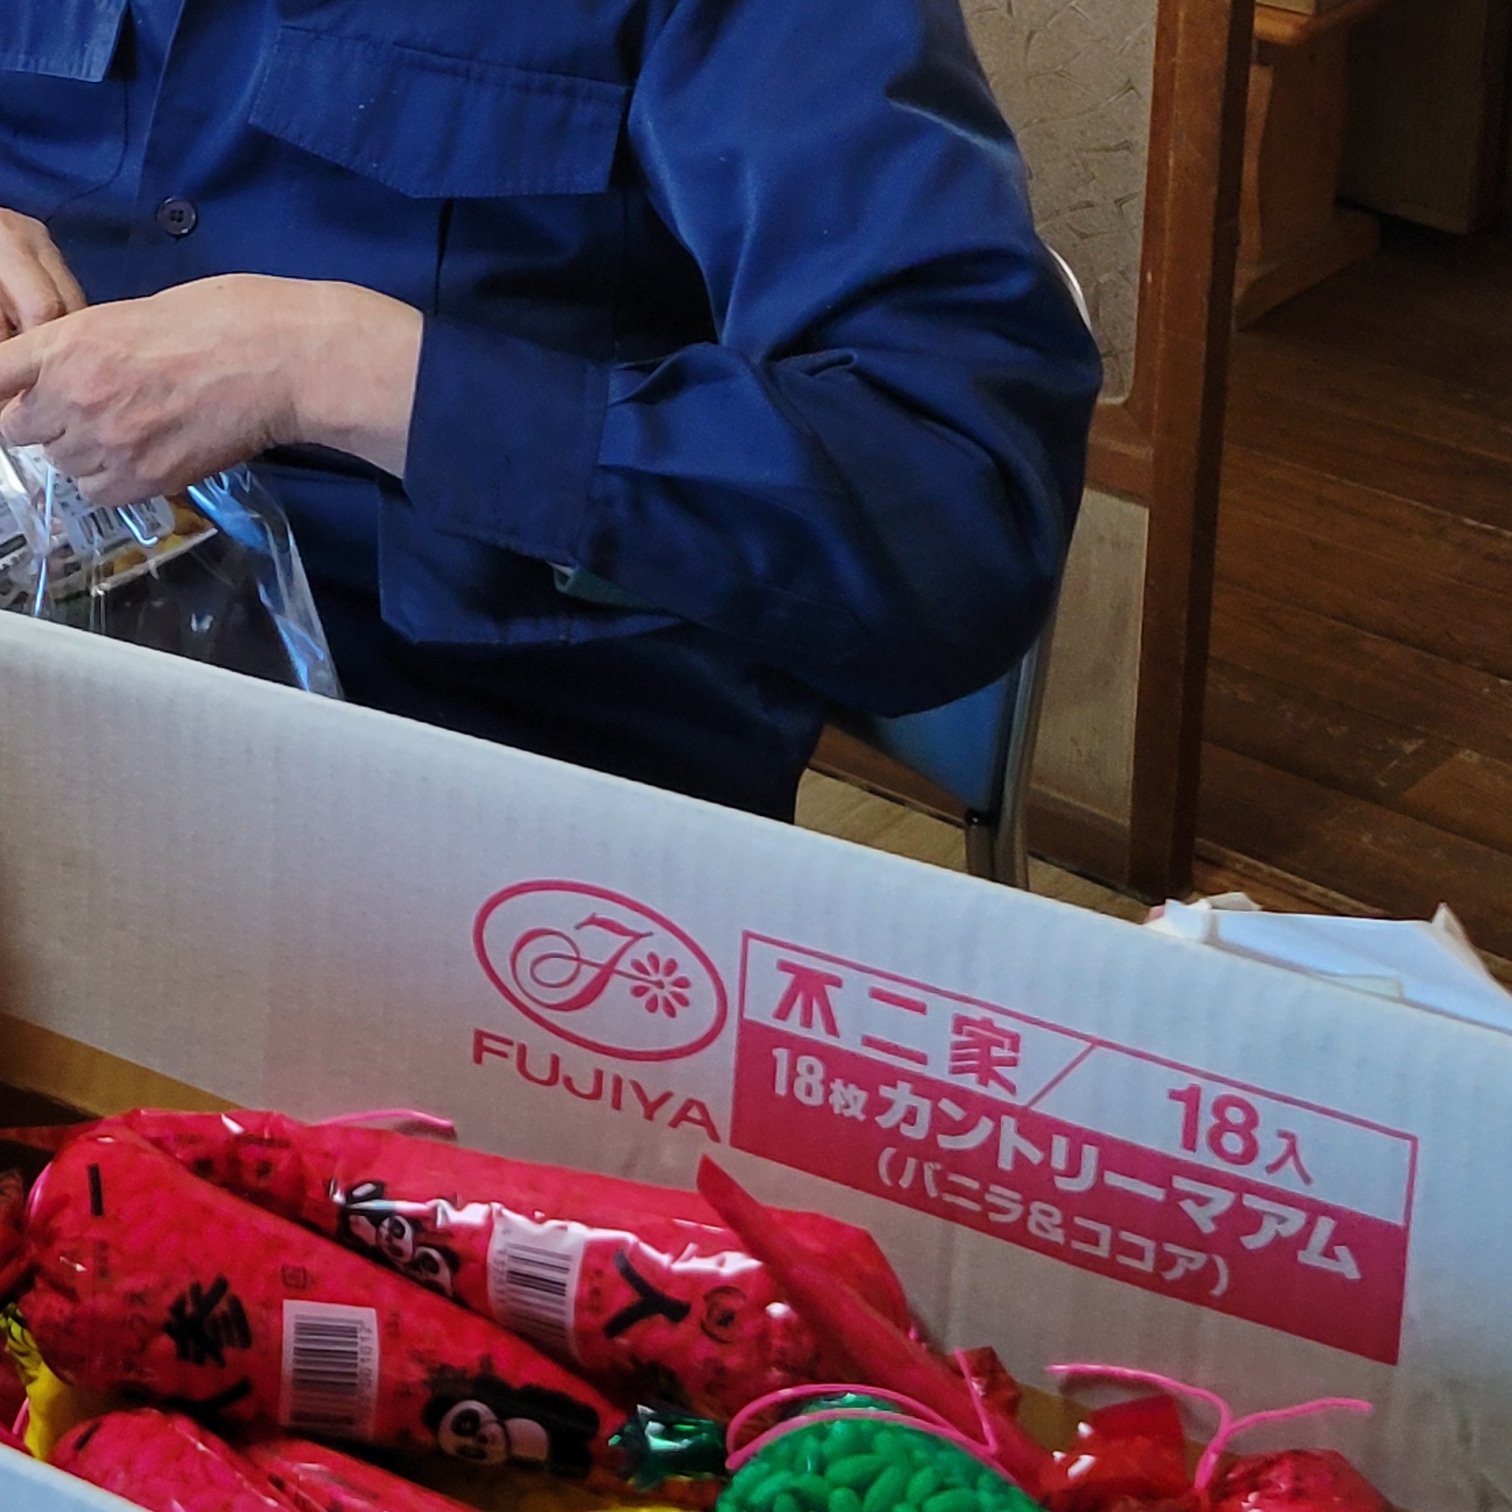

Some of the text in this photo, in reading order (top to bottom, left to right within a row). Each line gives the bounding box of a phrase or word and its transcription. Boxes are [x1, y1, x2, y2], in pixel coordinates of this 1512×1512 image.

[773, 959, 1021, 1096] 不二家
[472, 1028, 721, 1143] FUJIYA
[1169, 1083, 1313, 1186] 18入
